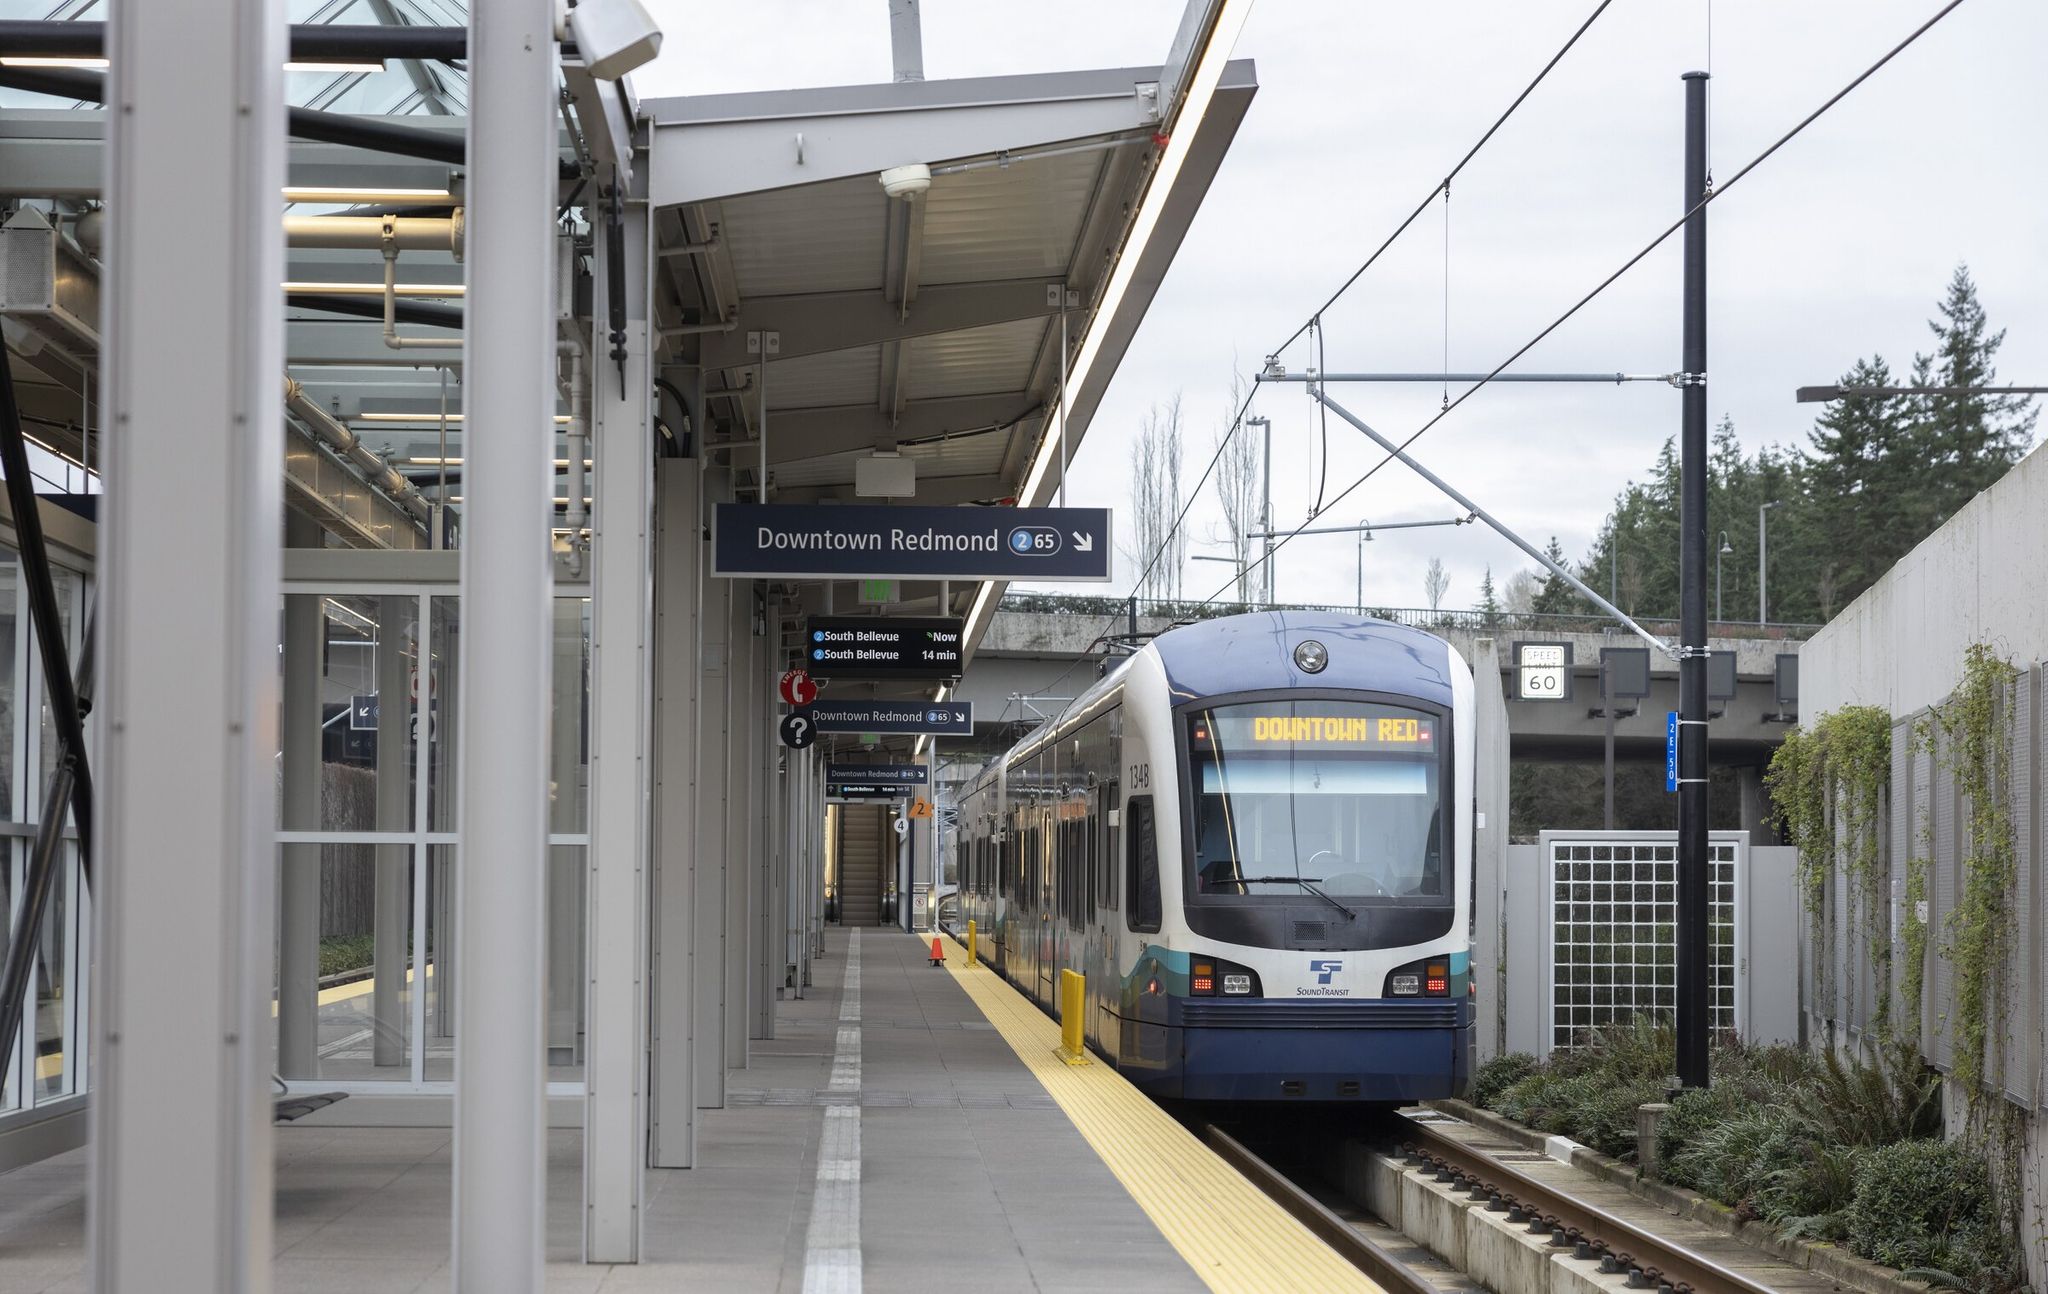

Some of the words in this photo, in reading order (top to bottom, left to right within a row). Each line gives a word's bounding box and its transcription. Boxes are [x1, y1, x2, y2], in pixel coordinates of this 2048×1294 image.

[757, 527, 882, 550] Downtown
[890, 528, 999, 552] Redmond
[1017, 533, 1028, 549] 2
[1034, 534, 1055, 549] 65
[824, 631, 854, 641] South
[856, 631, 900, 642] Bellevue
[933, 632, 957, 642] Now
[824, 649, 854, 659] South
[856, 650, 900, 660] Bellevue
[922, 650, 934, 660] 14
[936, 649, 957, 660] min
[1530, 675, 1556, 690] 60
[812, 710, 869, 721] Downtown
[872, 710, 922, 722] Redmond
[937, 713, 948, 721] 65
[1255, 717, 1367, 741] DOWNTOWN
[1378, 719, 1418, 741] RED
[868, 770, 899, 778] Redmond
[1130, 764, 1149, 789] 134B
[917, 802, 924, 815] 2
[897, 820, 905, 831] 4
